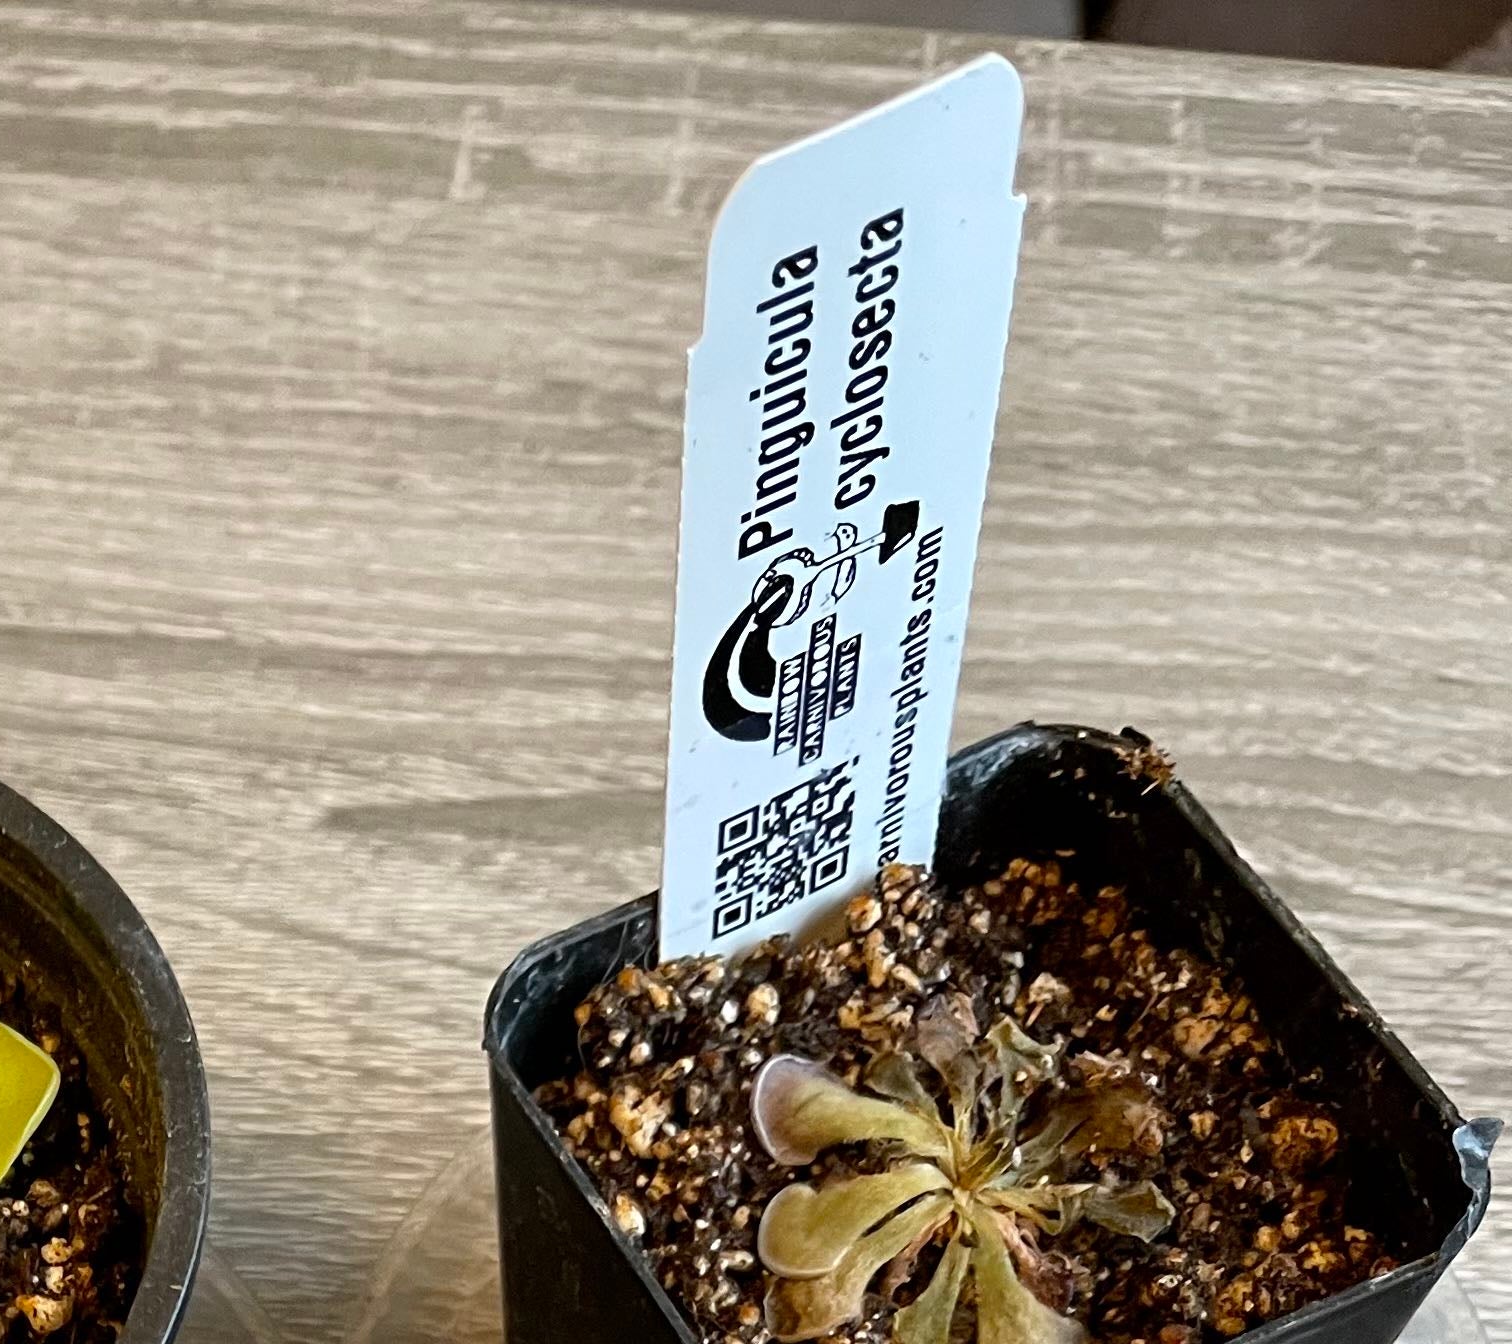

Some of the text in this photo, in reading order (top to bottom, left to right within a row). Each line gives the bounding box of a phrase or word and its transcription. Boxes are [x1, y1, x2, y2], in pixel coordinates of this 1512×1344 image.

[738, 244, 820, 561] Pinguicula
[830, 207, 906, 511] cyclosecta
[802, 615, 834, 765] CARNIVOROUS
[834, 636, 858, 719] PLANTS
